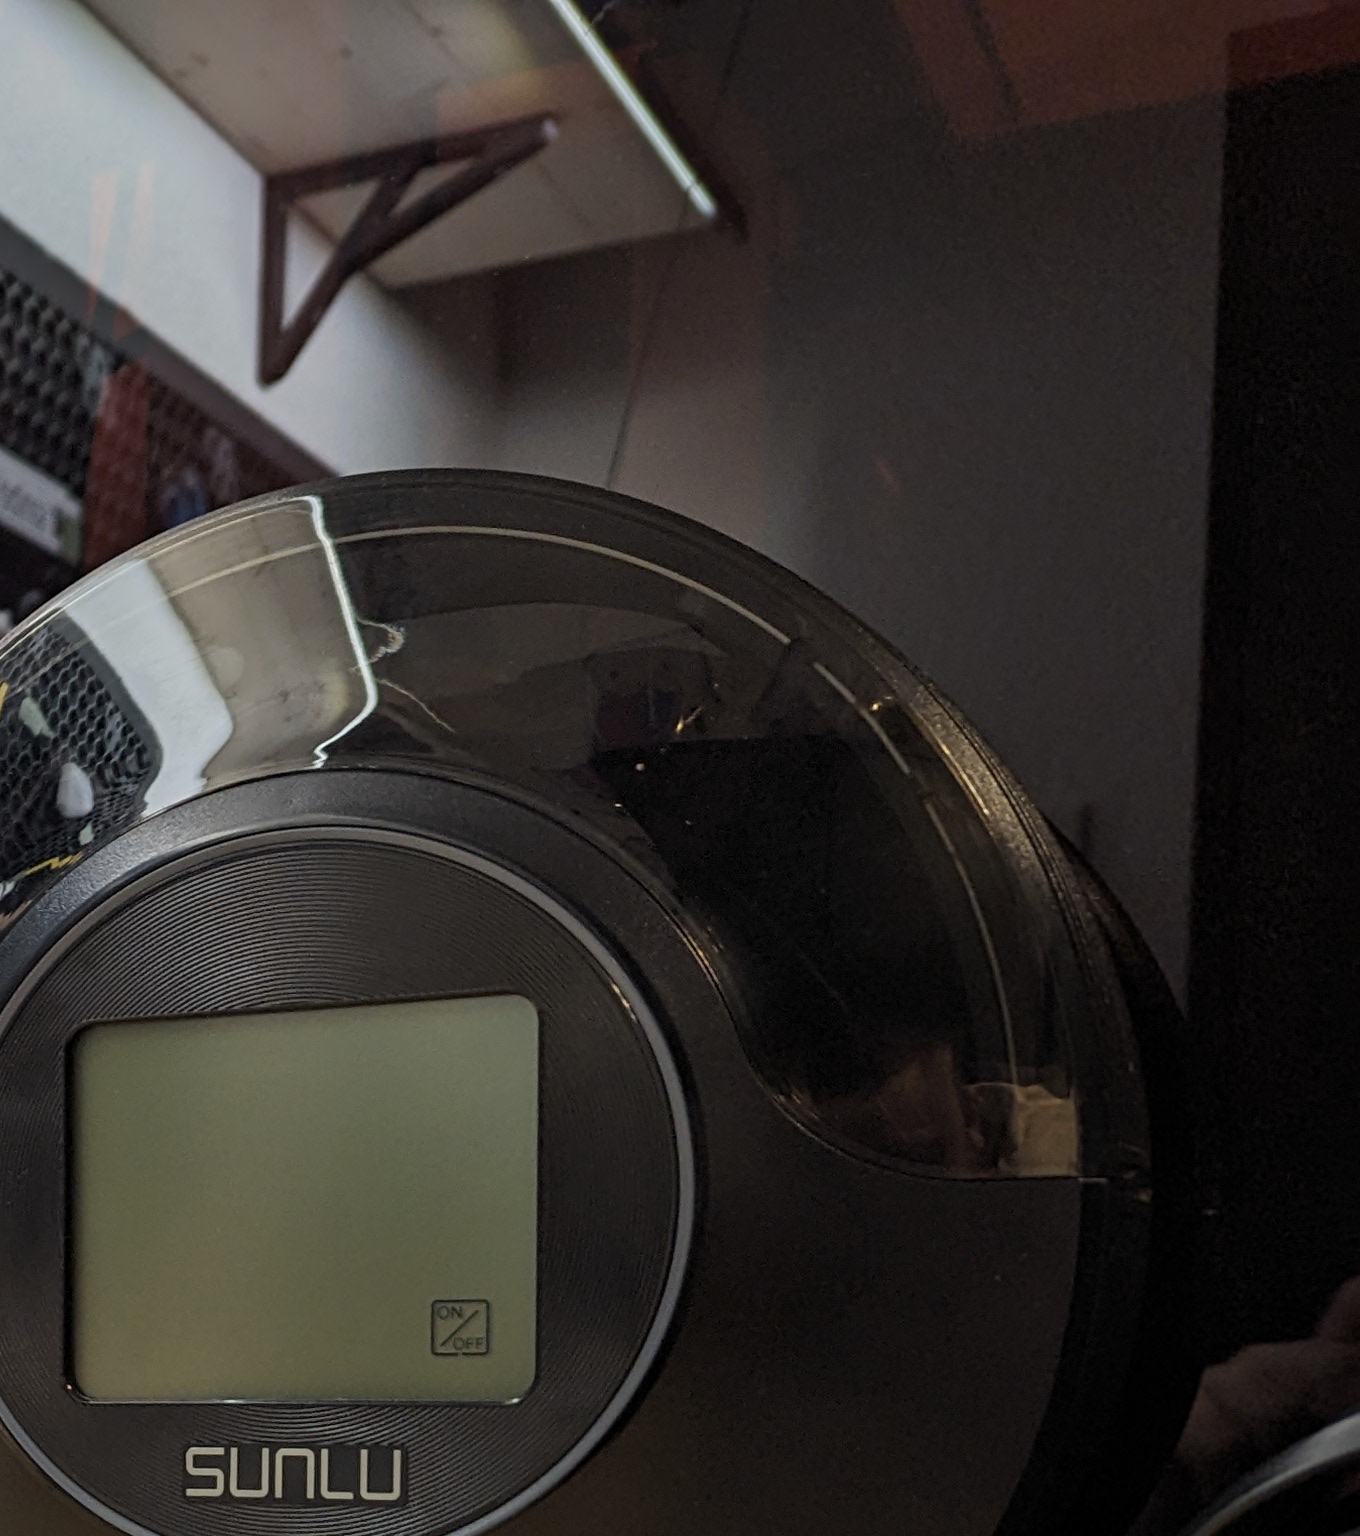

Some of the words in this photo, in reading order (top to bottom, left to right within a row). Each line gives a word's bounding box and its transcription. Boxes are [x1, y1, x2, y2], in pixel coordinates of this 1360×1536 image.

[436, 1305, 463, 1320] ON
[453, 1336, 485, 1351] OFF
[185, 1446, 402, 1501] SUNLU
